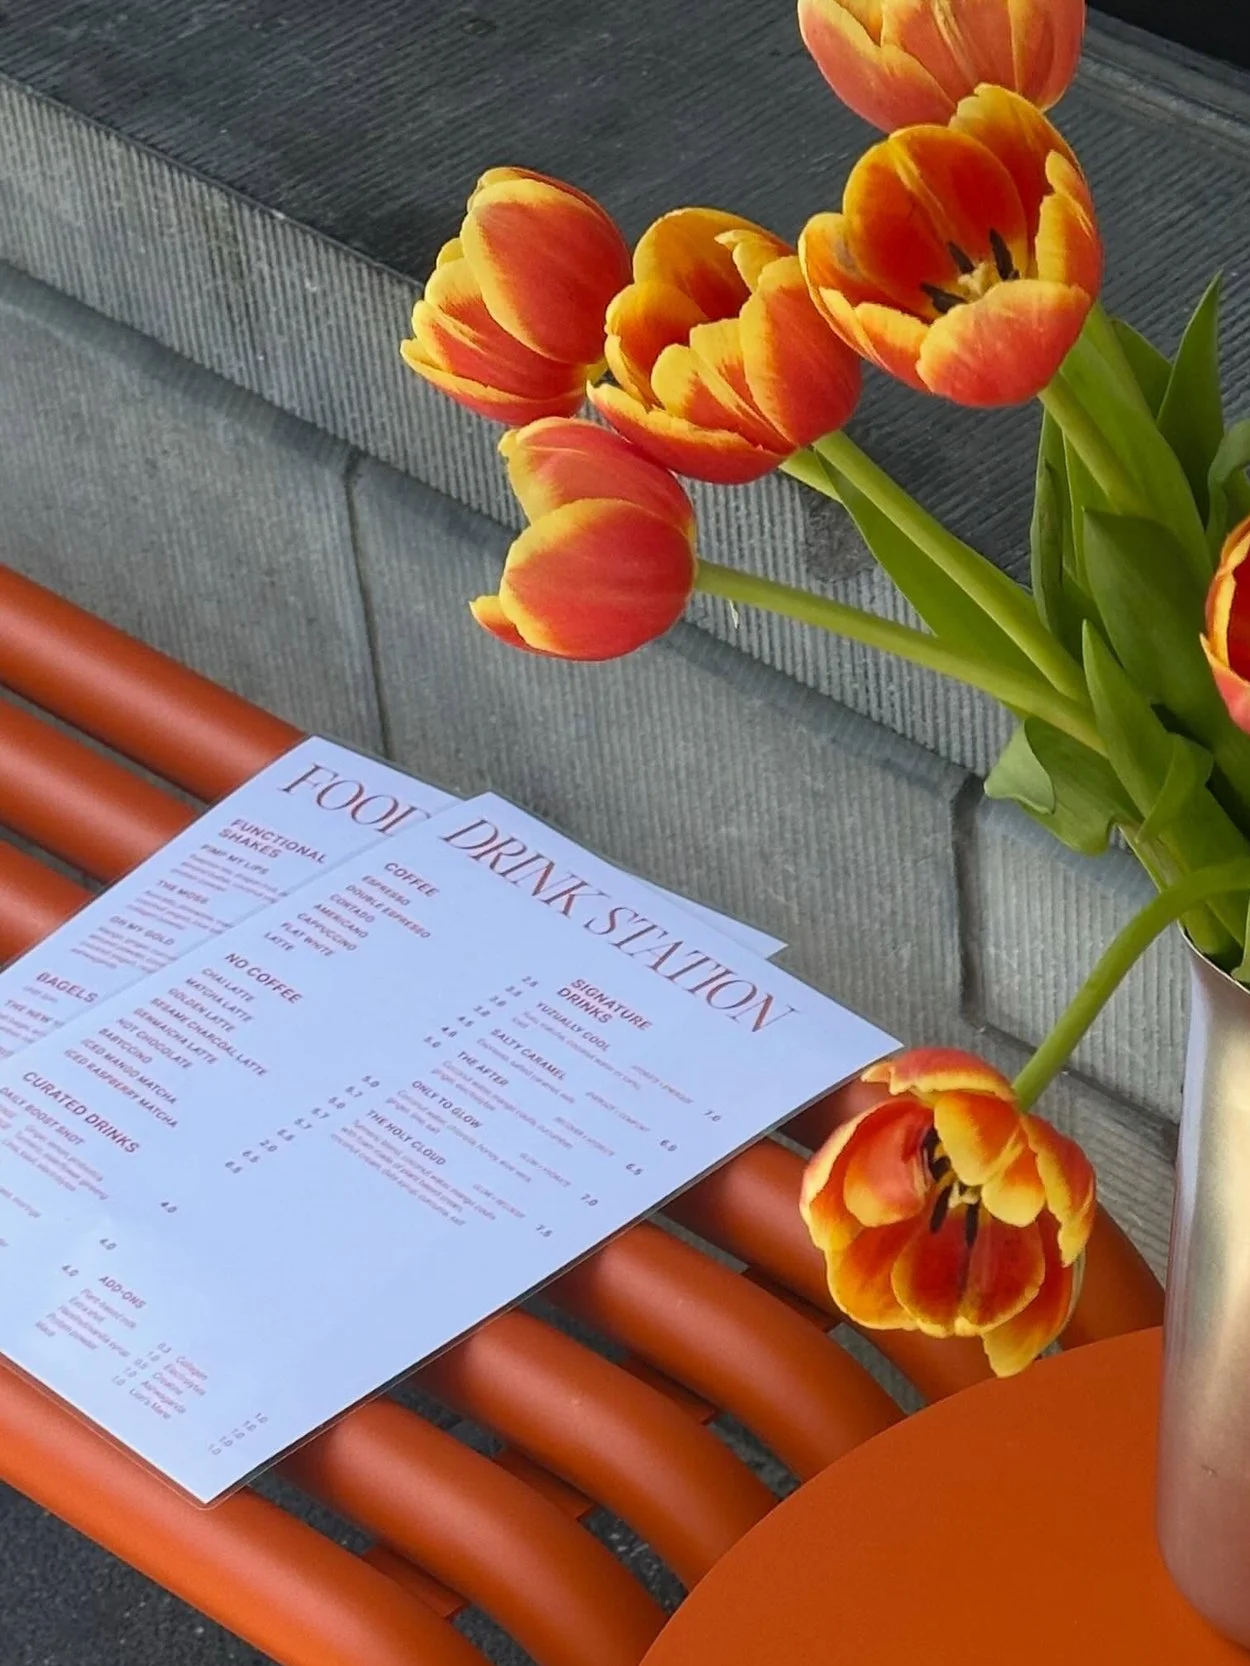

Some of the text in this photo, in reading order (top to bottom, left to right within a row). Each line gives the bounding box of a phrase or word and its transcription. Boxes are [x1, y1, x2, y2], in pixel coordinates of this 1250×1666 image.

[218, 828, 281, 858] SHAKES
[230, 818, 325, 863] FUNCTIONAL
[226, 854, 245, 864] MY
[242, 861, 269, 875] LIPS
[383, 862, 438, 896] COFFEE
[328, 893, 375, 923] CORTADO
[345, 884, 431, 938] DOUBLE ESPRESSO
[361, 874, 410, 906] ESPRESSO
[126, 922, 144, 932] MY
[143, 929, 175, 946] GOLD
[263, 931, 294, 951] LATTE
[280, 921, 335, 956] FLAT WHITE
[296, 912, 357, 951] CAPPUCCINO
[313, 903, 368, 938] AMERICANO
[442, 819, 793, 1031] DRINK STATION
[35, 971, 98, 1003] BAGELS
[201, 967, 255, 1002] CHAI LATTE
[223, 952, 302, 1003] NO COFFEE
[167, 987, 235, 1032] GOLDEN LATTE
[184, 977, 252, 1022] MATCHA LATTE
[556, 987, 612, 1023] DRINKS
[570, 978, 651, 1029] SIGNATURE
[98, 1027, 152, 1064] BABYCCINO
[115, 1017, 192, 1069] HOT CHOCOLATE
[133, 1007, 218, 1064] GENMAICHA LATTE
[150, 997, 267, 1076] SESAME CHARCOAL LATTE
[536, 1001, 584, 1032] YUZUALLY
[581, 1031, 610, 1051] COOL
[80, 1038, 176, 1104] ICED MANGO MATCHA
[456, 1050, 508, 1086] THE AFTER
[490, 1028, 564, 1079] SALTY CARAMEL
[63, 1048, 177, 1127] ICED RASPBERRY MATCHA
[411, 1080, 482, 1128] ONLY TO GLOW
[0, 1086, 27, 1106] DAILY
[23, 1103, 59, 1127] BOOST
[54, 1125, 85, 1145] SHOT
[22, 1071, 87, 1115] CURATED
[83, 1113, 139, 1153] DRINKS
[366, 1109, 387, 1125] THE
[384, 1122, 413, 1142] HOLY
[409, 1140, 446, 1165] CLOUD
[159, 1201, 177, 1213] 4.0
[60, 1264, 79, 1277] 4.0
[98, 1275, 145, 1308] ADD-ONS
